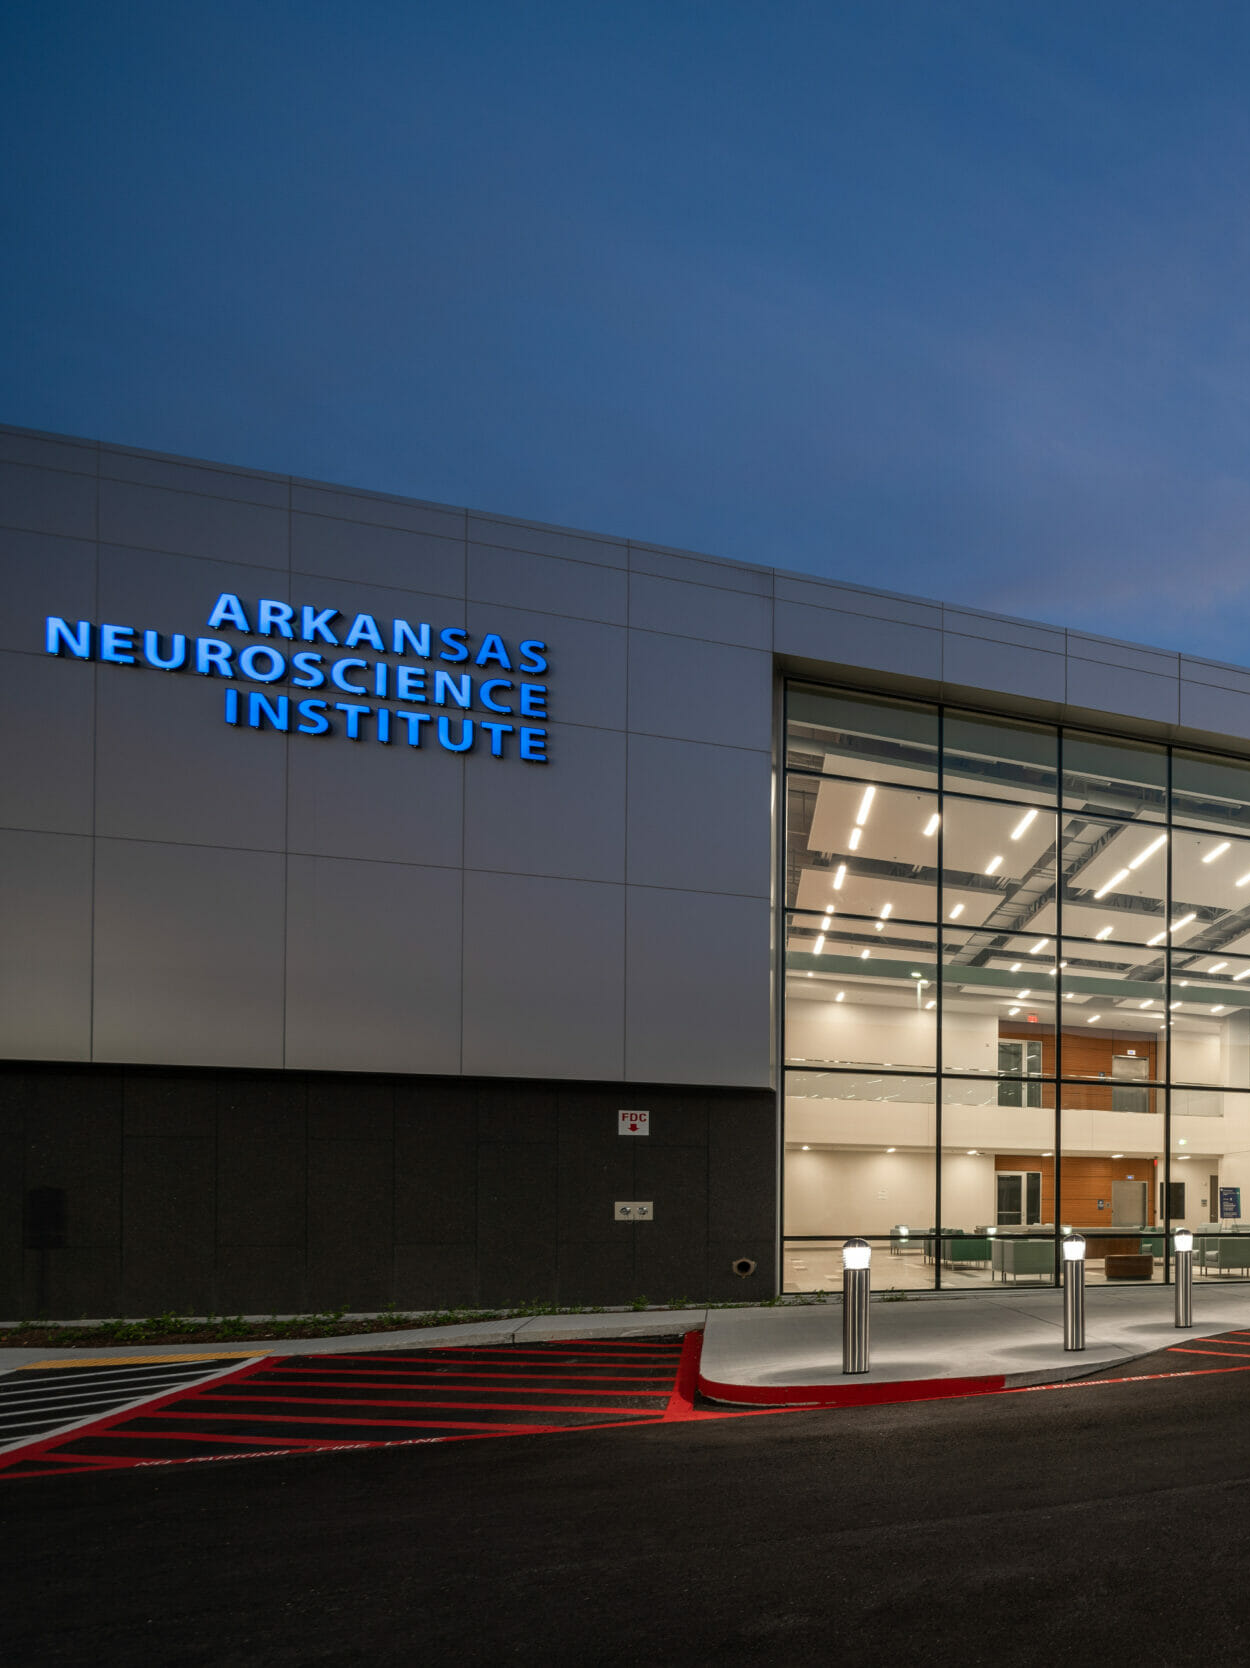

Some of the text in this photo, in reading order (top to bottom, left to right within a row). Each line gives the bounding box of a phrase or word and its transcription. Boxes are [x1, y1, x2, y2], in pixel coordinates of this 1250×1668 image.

[46, 615, 548, 719] NEUROSCIENCE
[207, 592, 548, 675] ARKANSAS
[225, 687, 548, 762] INSTITUTE
[621, 1112, 647, 1122] FDC
[1053, 1380, 1109, 1389] PARKING
